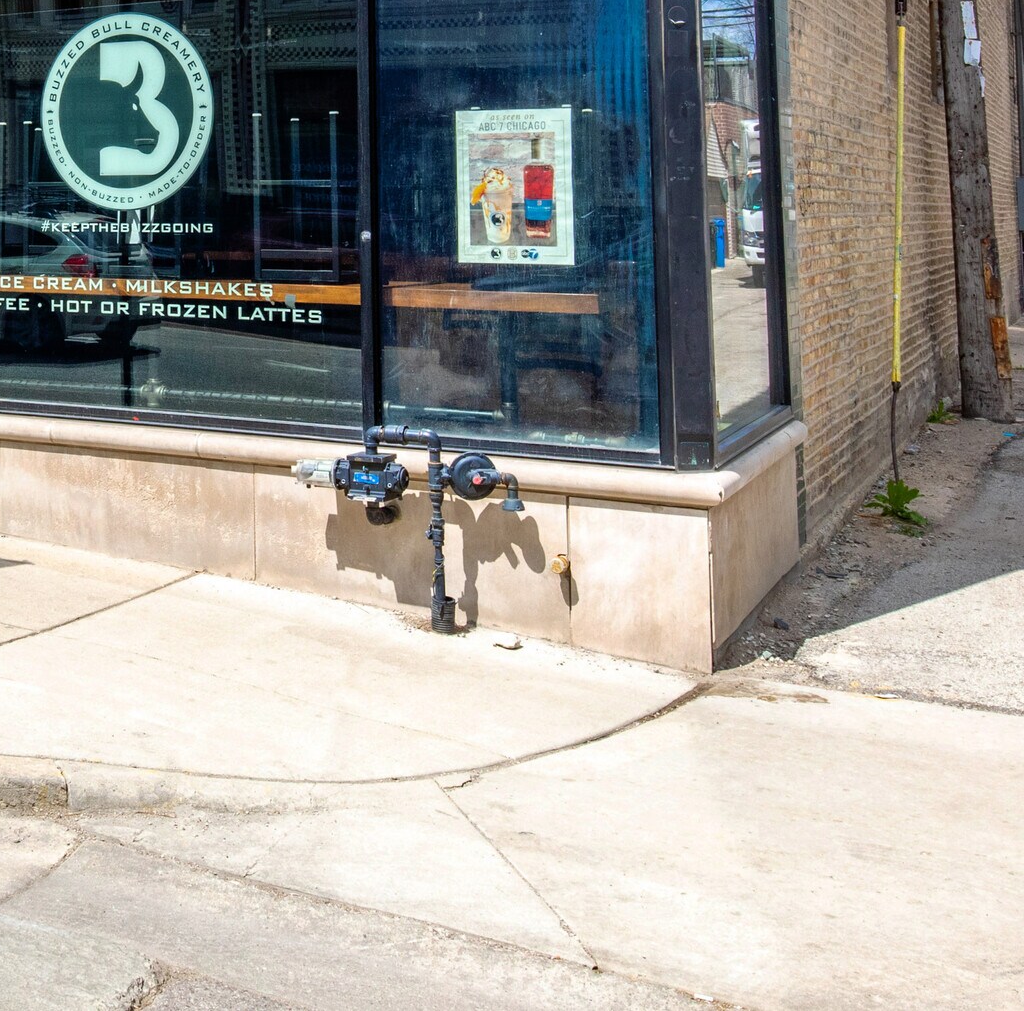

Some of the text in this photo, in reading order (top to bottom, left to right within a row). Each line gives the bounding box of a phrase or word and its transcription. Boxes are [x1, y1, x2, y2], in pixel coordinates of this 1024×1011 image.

[49, 20, 205, 102] BUZZED BULL CREAMERY
[478, 121, 546, 131] ABC 7 CHICAGO
[68, 170, 134, 203] NON-BUZZED
[148, 115, 207, 198] MADE-TO-ORDER
[33, 276, 104, 292] CREAM
[126, 280, 273, 297] MILKSHAKES
[50, 299, 92, 314] HOT
[100, 301, 129, 315] OR
[139, 302, 227, 320] FROZEN
[237, 306, 323, 324] LATTES
